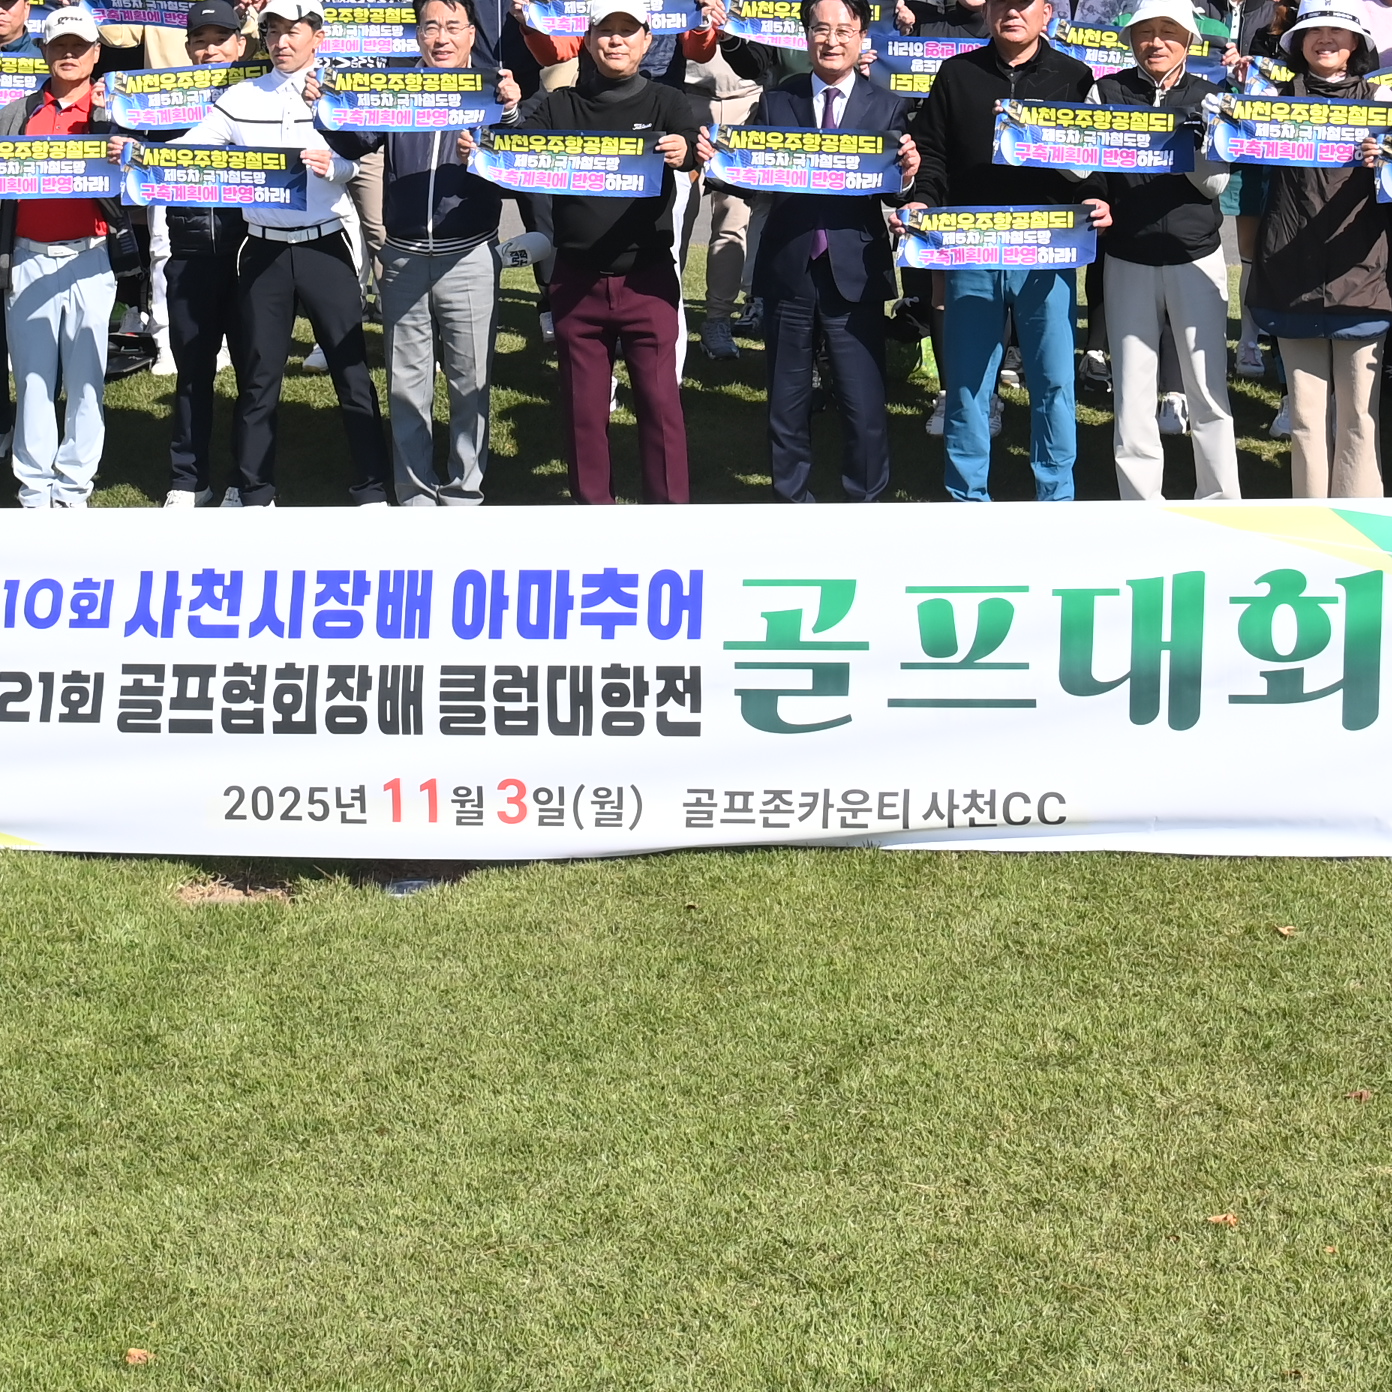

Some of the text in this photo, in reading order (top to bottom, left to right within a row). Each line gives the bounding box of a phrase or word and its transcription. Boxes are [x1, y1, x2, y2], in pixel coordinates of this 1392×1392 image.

[335, 72, 482, 92] 사천우주항공철도!
[356, 92, 461, 106] 제5차 국가철도망
[332, 108, 485, 126] 구축계획에 반영하라!
[1019, 105, 1173, 133] 사천우주항공철도!
[1041, 127, 1150, 147] 제5차 국가철도망
[1254, 122, 1296, 138] 제5차
[493, 132, 643, 157] 사천우주항공철도!
[728, 128, 882, 155] 사천우주항공철도!
[1227, 137, 1314, 160] 구축계획에
[142, 147, 286, 171] 사천우주항공철도!
[513, 152, 620, 171] 제5차 국가철도망
[750, 150, 859, 169] 제5차 국가철도망
[1014, 142, 1098, 165] 구축계획에
[23, 160, 86, 174] 국가철도망
[163, 167, 266, 184] 제5차 국가철도망
[724, 165, 883, 190] 구축계획에 반영하라!
[41, 175, 109, 193] 반영하라!
[487, 168, 643, 192] 구축계획에 반영하라!
[140, 182, 291, 204] 구축계획에 반영하라!
[921, 211, 1074, 230] 사천우주항공철도!
[942, 230, 1051, 245] 제5차 국가철도망
[917, 245, 1077, 264] 구축계획에 반영하라!
[122, 568, 432, 640] 사천시장배
[451, 567, 704, 640] 아마추어
[722, 568, 1384, 735] 골프대회
[116, 663, 424, 735] 골프협회장배
[437, 663, 703, 738] 클럽대항전
[222, 776, 1068, 831] 2025년 11월 3일(월) 골프존카운티 사천CC
